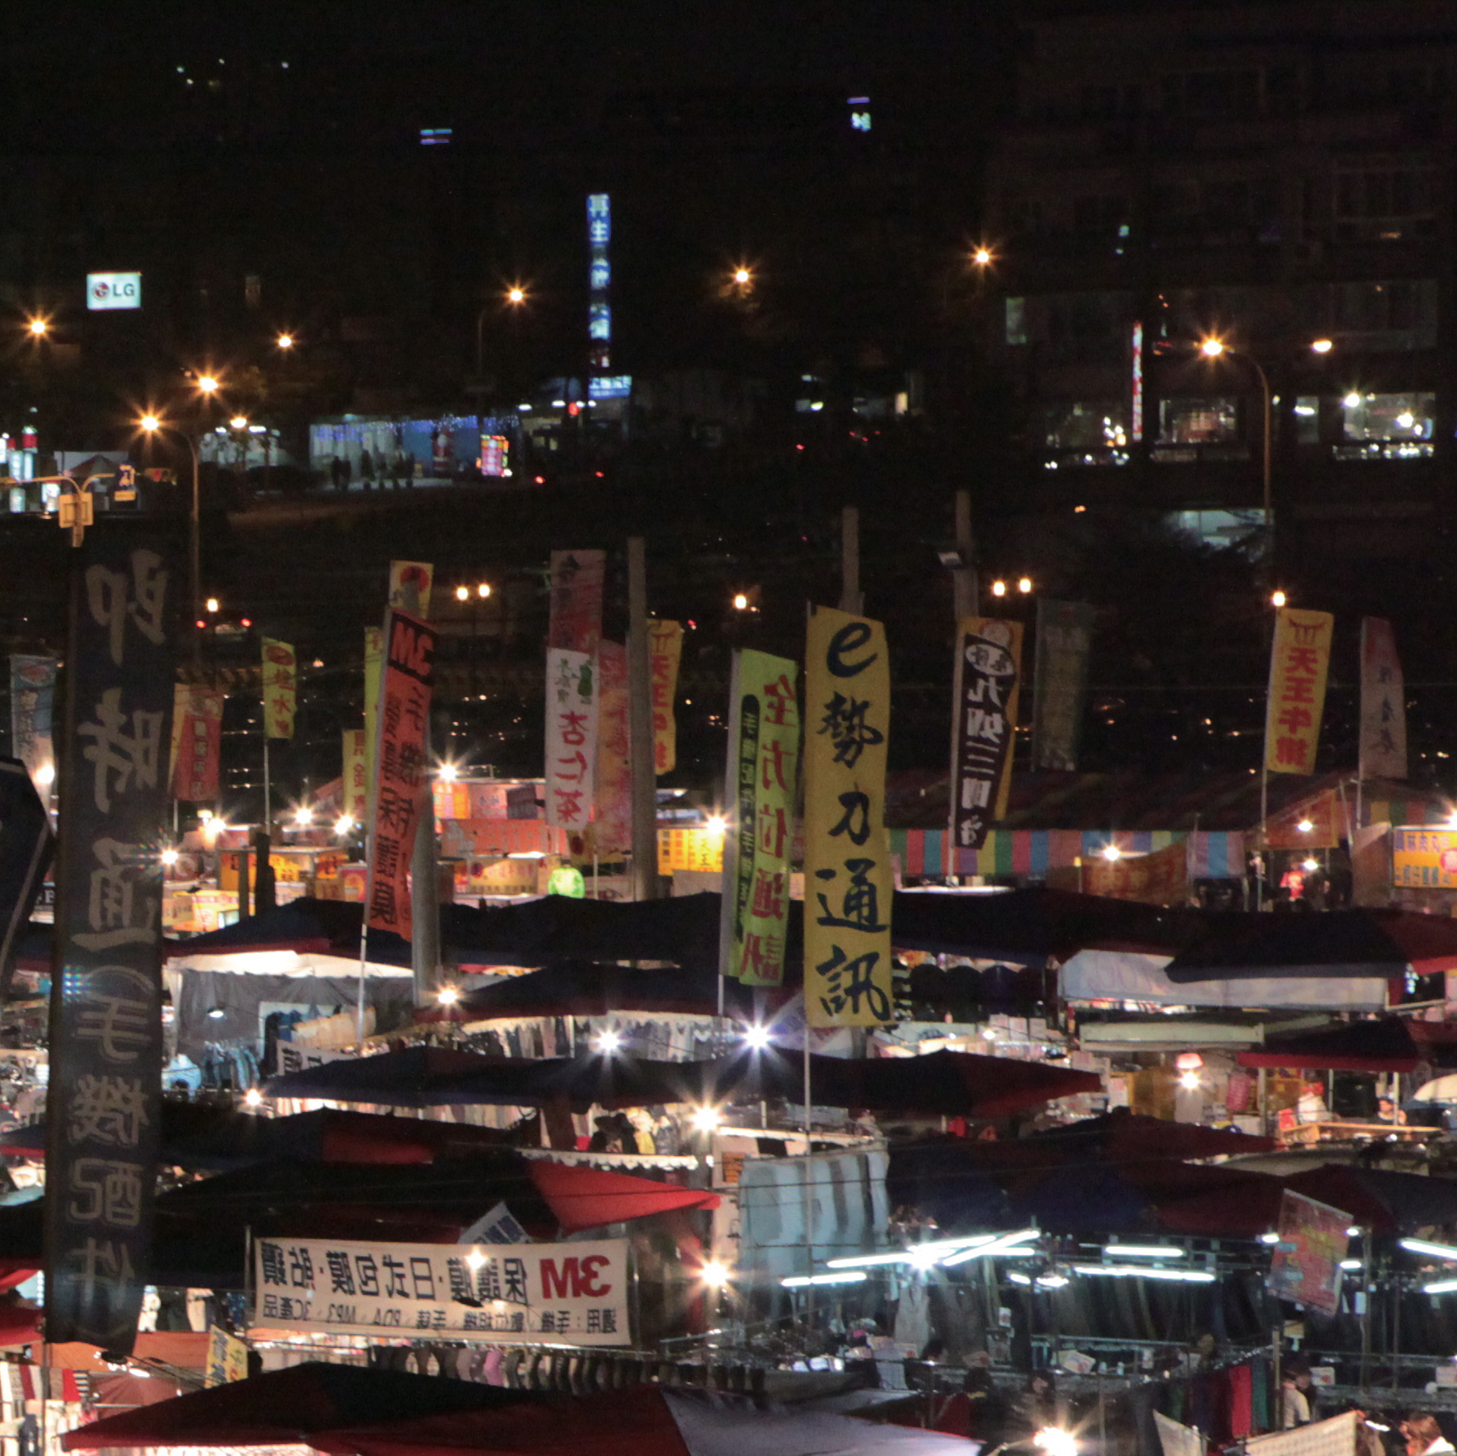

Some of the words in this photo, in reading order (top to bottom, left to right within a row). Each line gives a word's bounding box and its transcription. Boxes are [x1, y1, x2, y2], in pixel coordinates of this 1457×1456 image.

[112, 283, 135, 297] LG
[816, 622, 890, 1021] e勢力通訊
